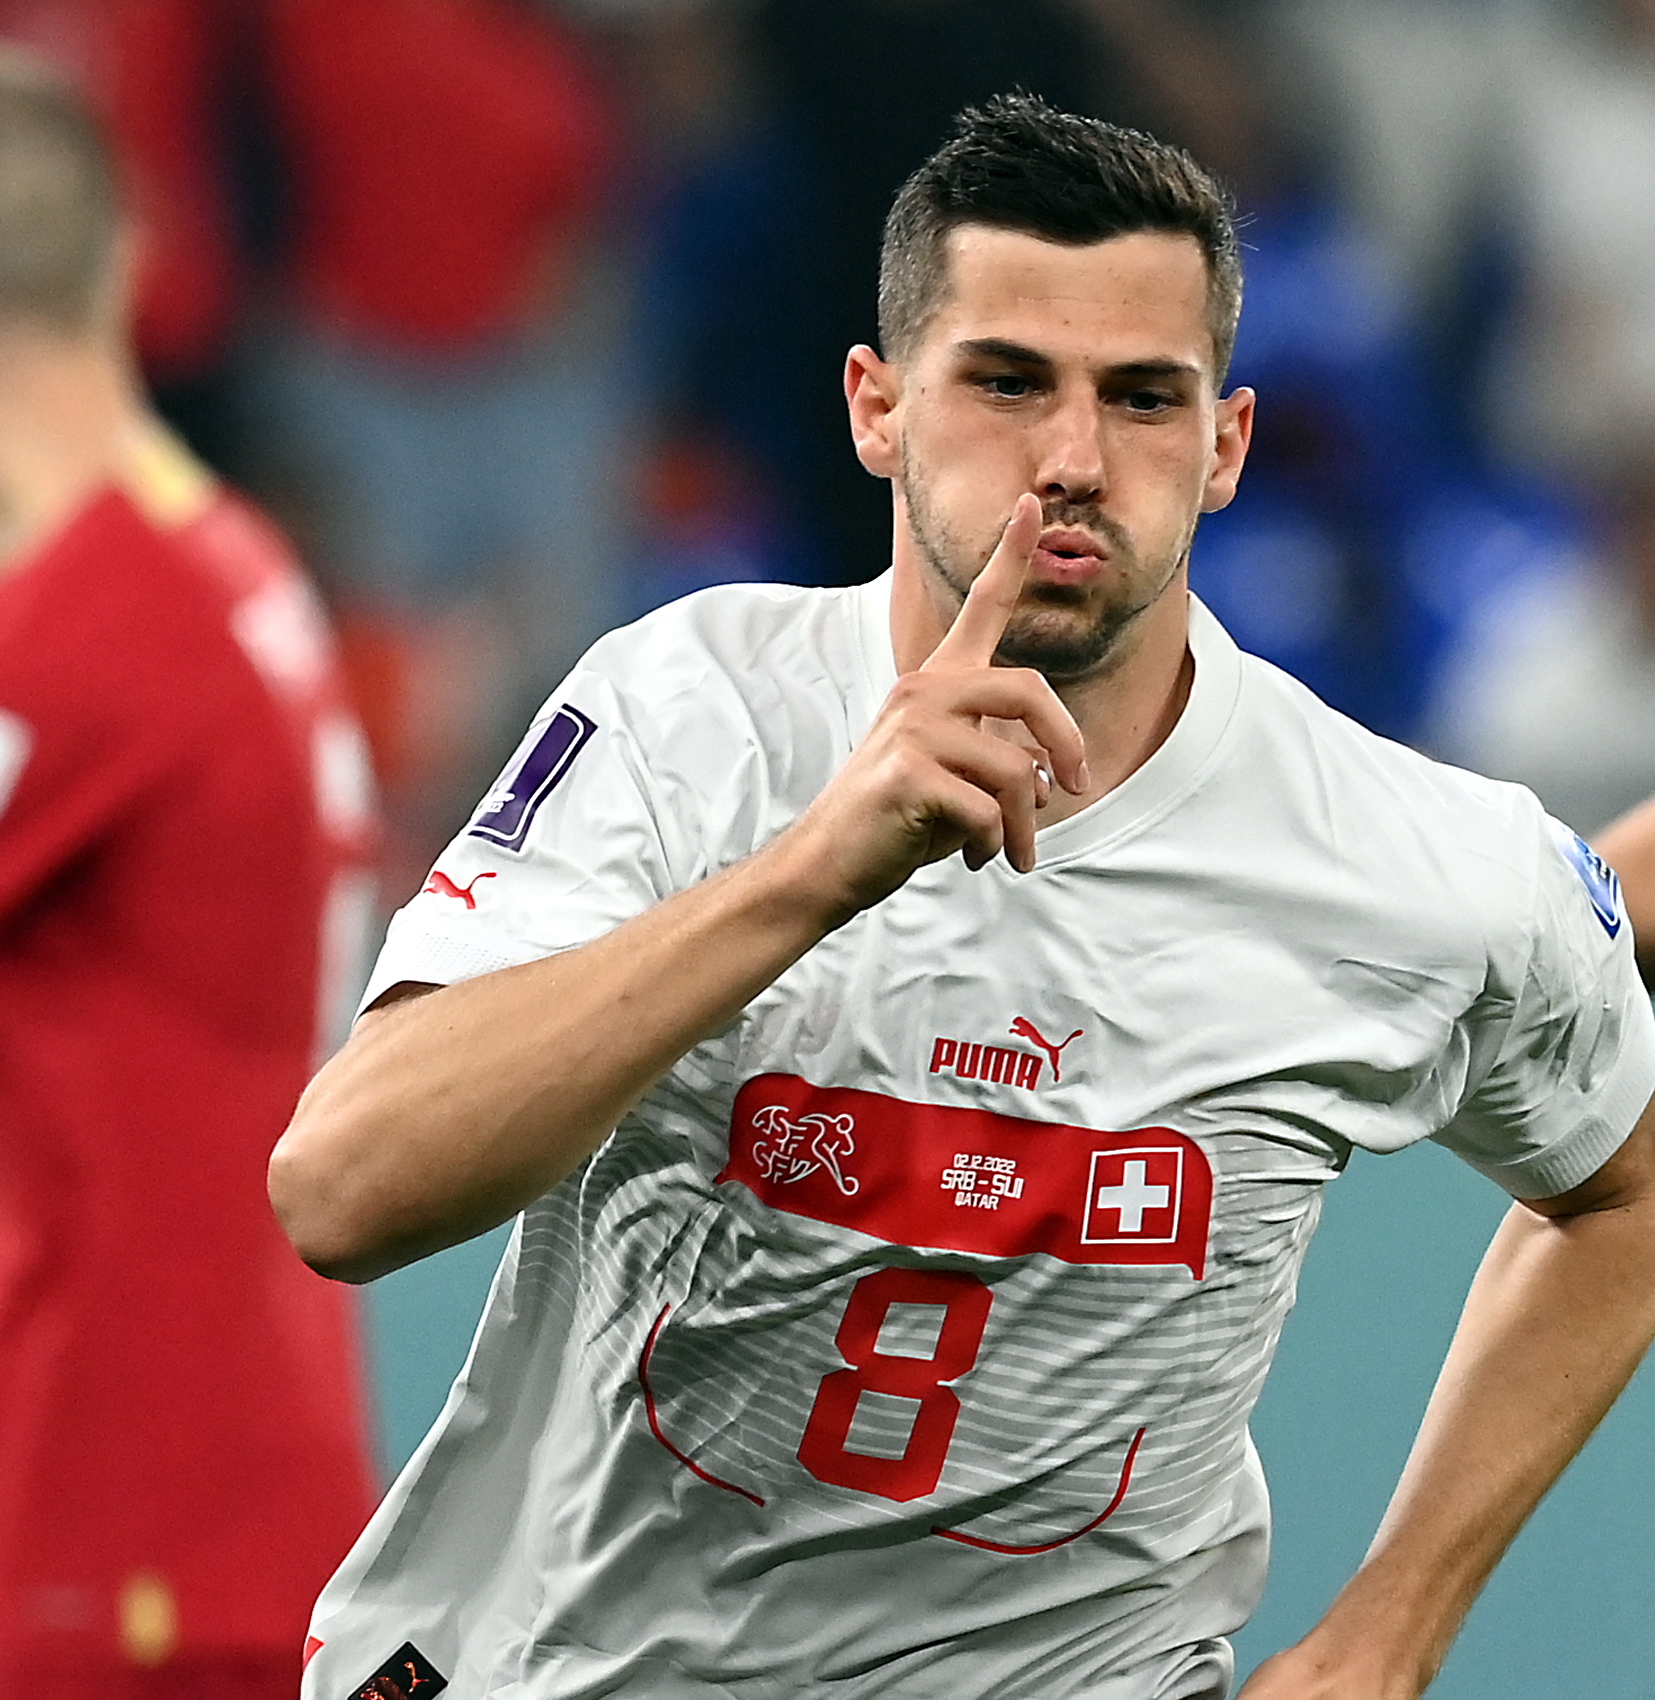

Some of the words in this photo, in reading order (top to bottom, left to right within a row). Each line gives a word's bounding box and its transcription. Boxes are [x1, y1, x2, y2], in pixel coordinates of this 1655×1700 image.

[929, 1036, 1044, 1092] PUMA
[940, 1168, 977, 1191] SRB
[990, 1173, 1025, 1199] SUI
[954, 1191, 1000, 1211] QATAR
[796, 1265, 994, 1503] 8
